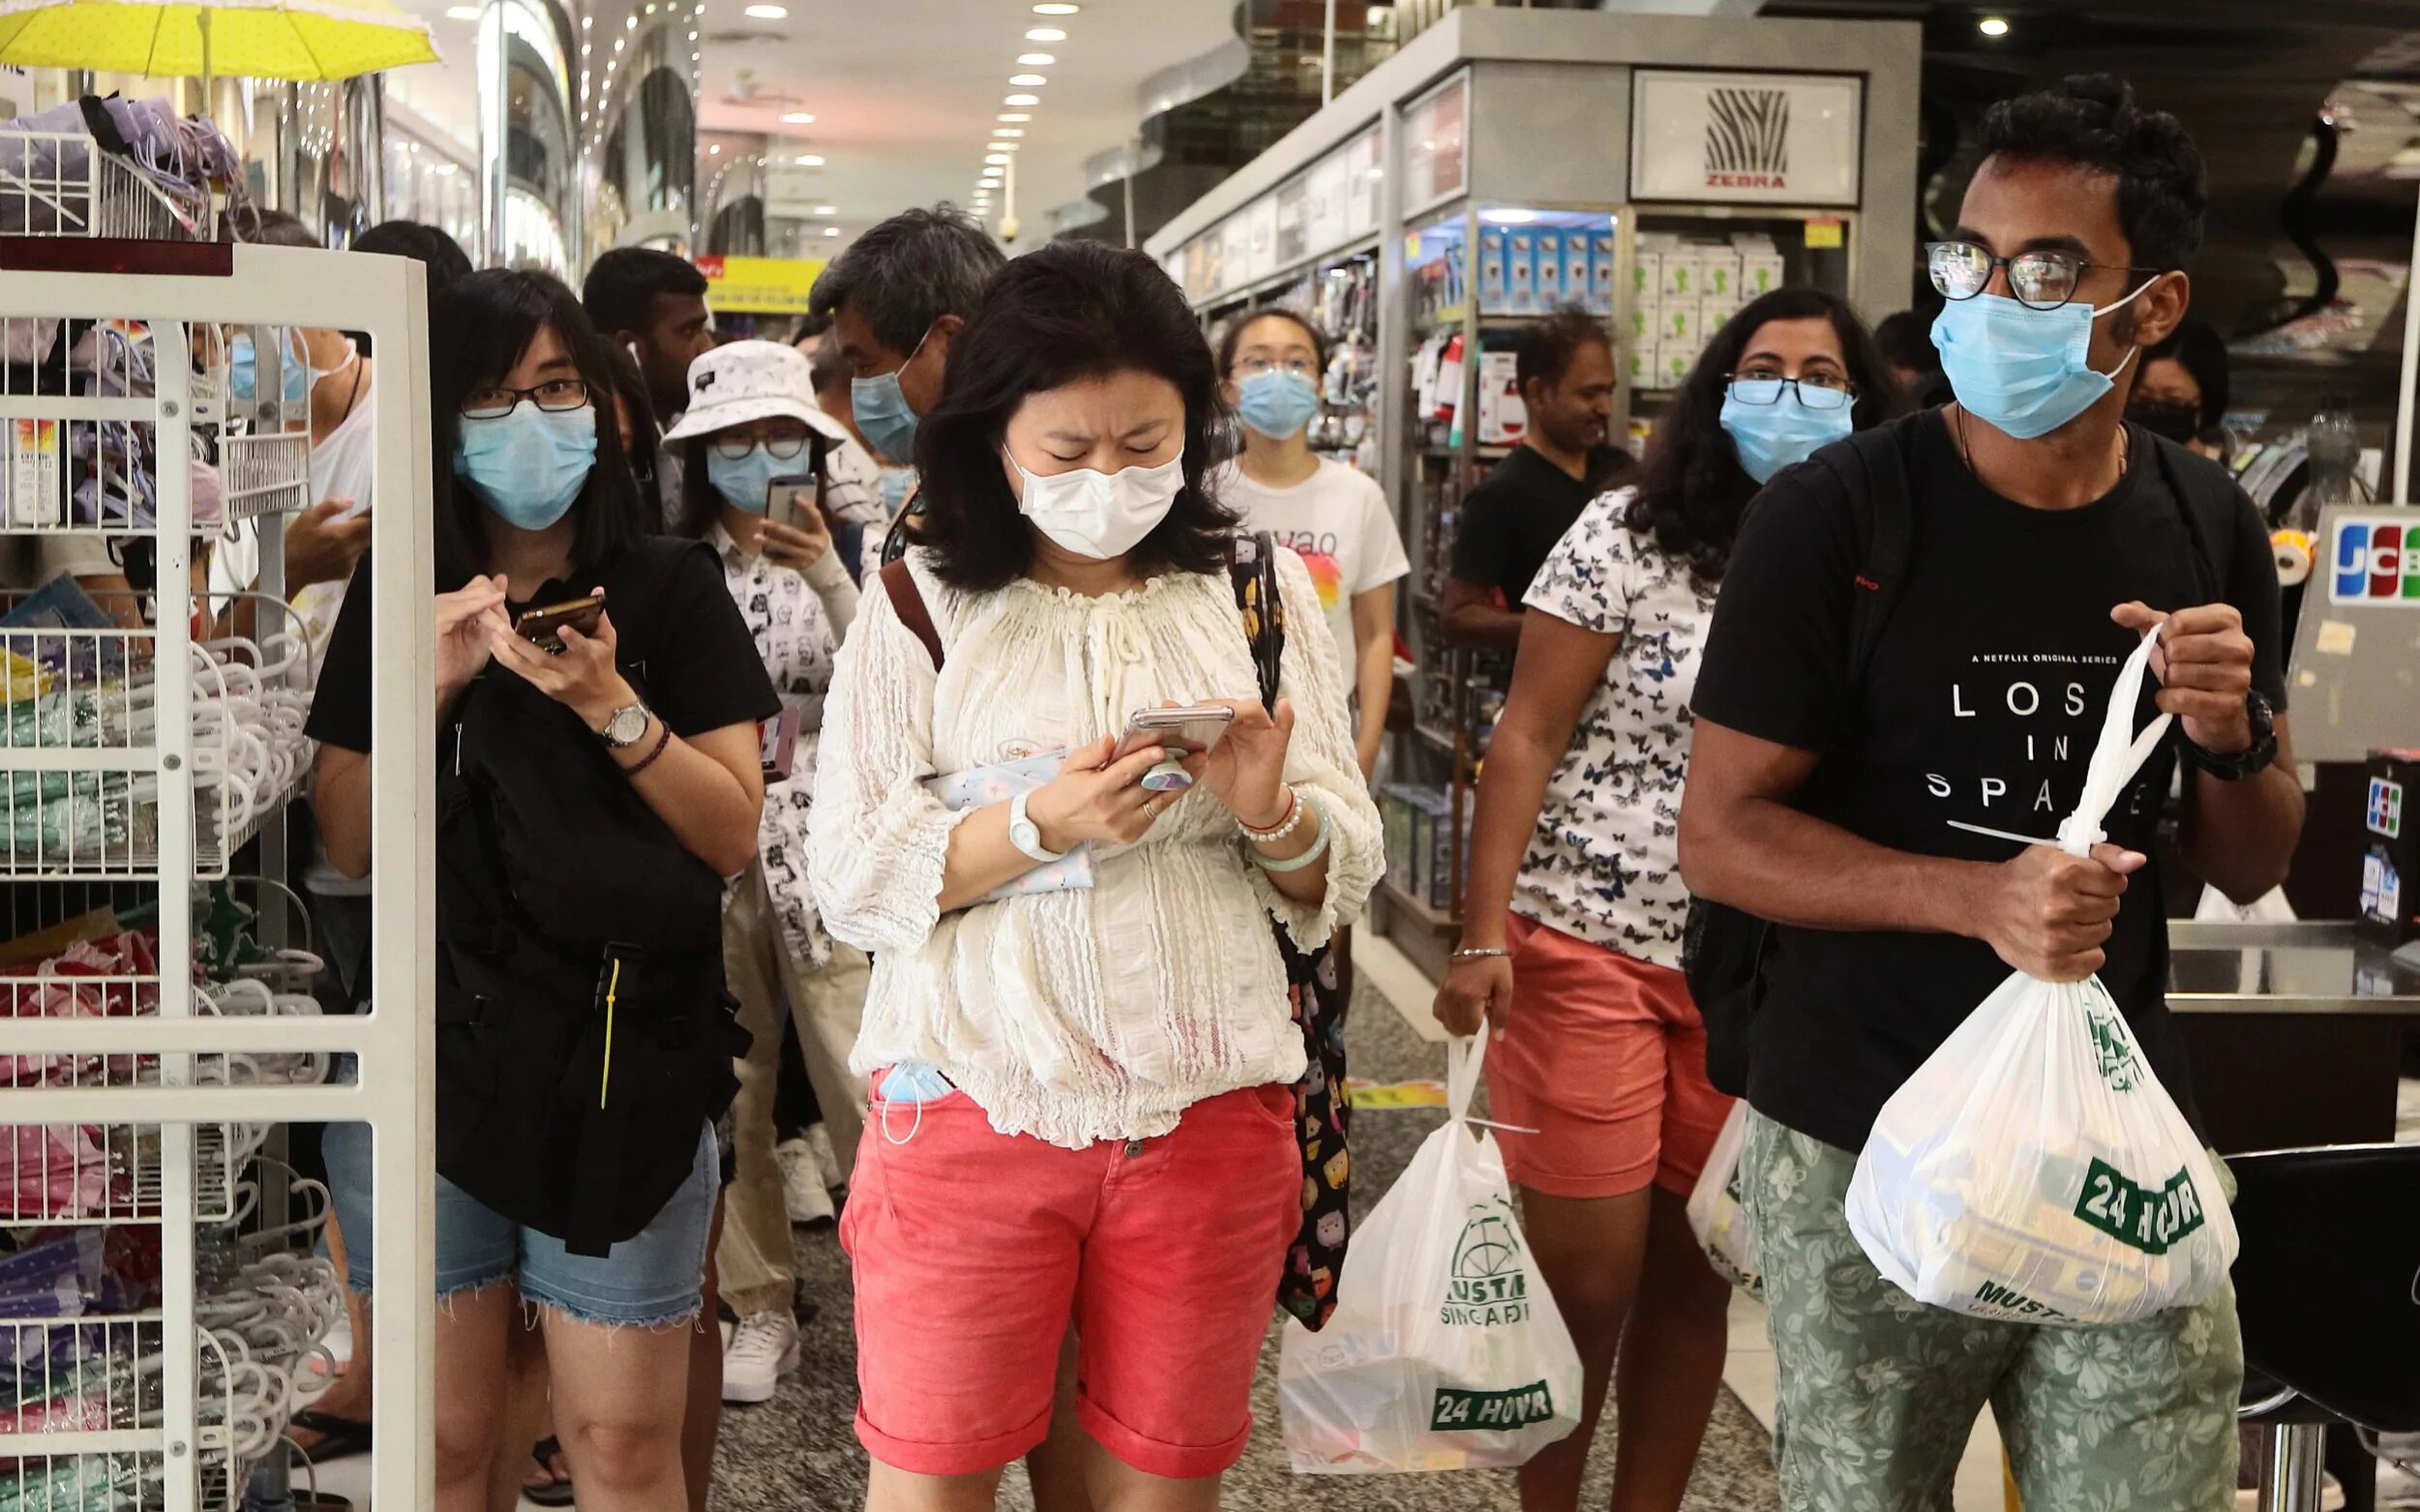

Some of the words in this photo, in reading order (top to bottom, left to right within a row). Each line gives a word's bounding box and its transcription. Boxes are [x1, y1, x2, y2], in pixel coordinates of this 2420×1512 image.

[1706, 174, 1786, 189] ZEBRA
[1984, 654, 2029, 664] NETFLIX
[2033, 654, 2078, 664] ORIGINAL
[2081, 656, 2118, 666] SERIES
[1953, 681, 2086, 717] LOS
[2027, 735, 2068, 761] IN
[1926, 773, 2147, 815] SPAE
[2085, 1173, 2128, 1230] 24
[1436, 1395, 1473, 1423] 24
